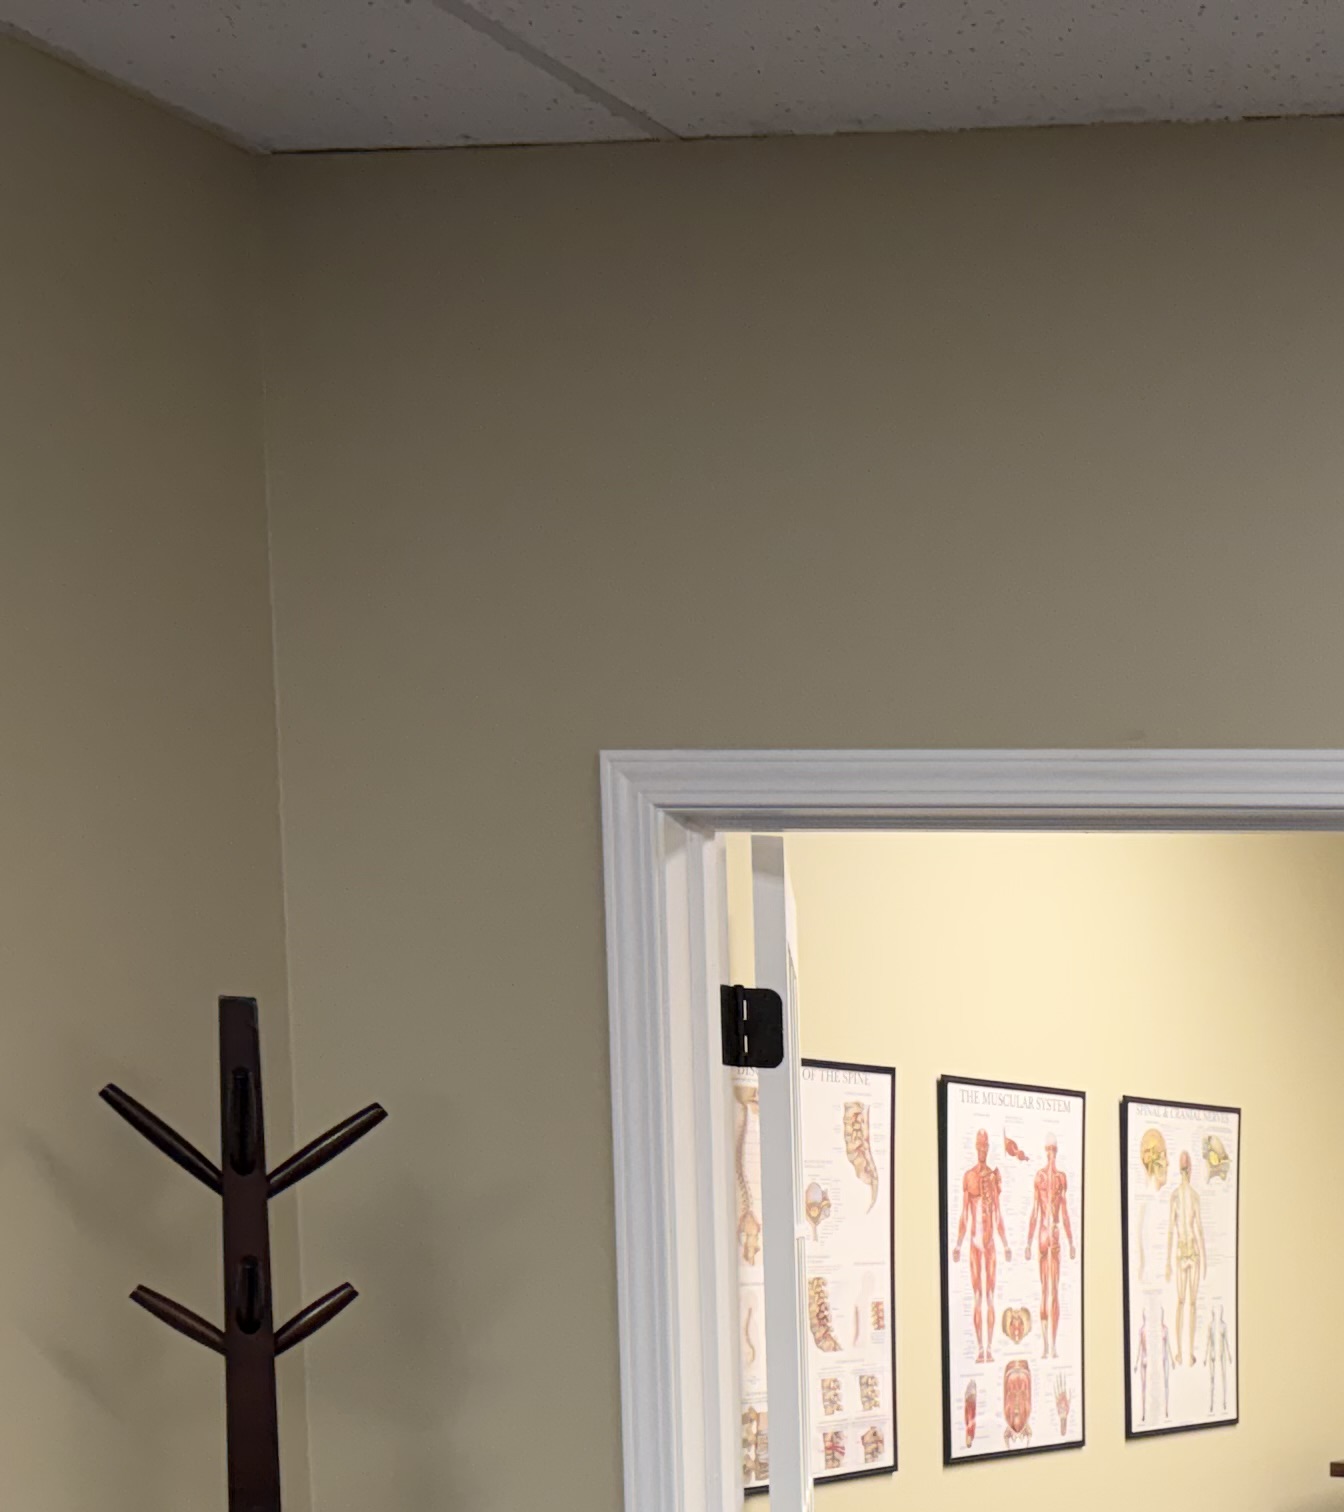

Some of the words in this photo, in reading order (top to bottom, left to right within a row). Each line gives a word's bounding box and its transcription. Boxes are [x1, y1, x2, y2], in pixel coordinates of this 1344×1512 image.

[802, 1068, 814, 1081] OF
[819, 1069, 841, 1083] THE
[842, 1070, 871, 1086] SPINE
[960, 1088, 980, 1104] THE
[982, 1091, 1035, 1110] MUSCULAR
[1036, 1098, 1071, 1113] SYSTEM
[1136, 1104, 1161, 1118] SPINAL
[1170, 1107, 1202, 1121] CRANIAL
